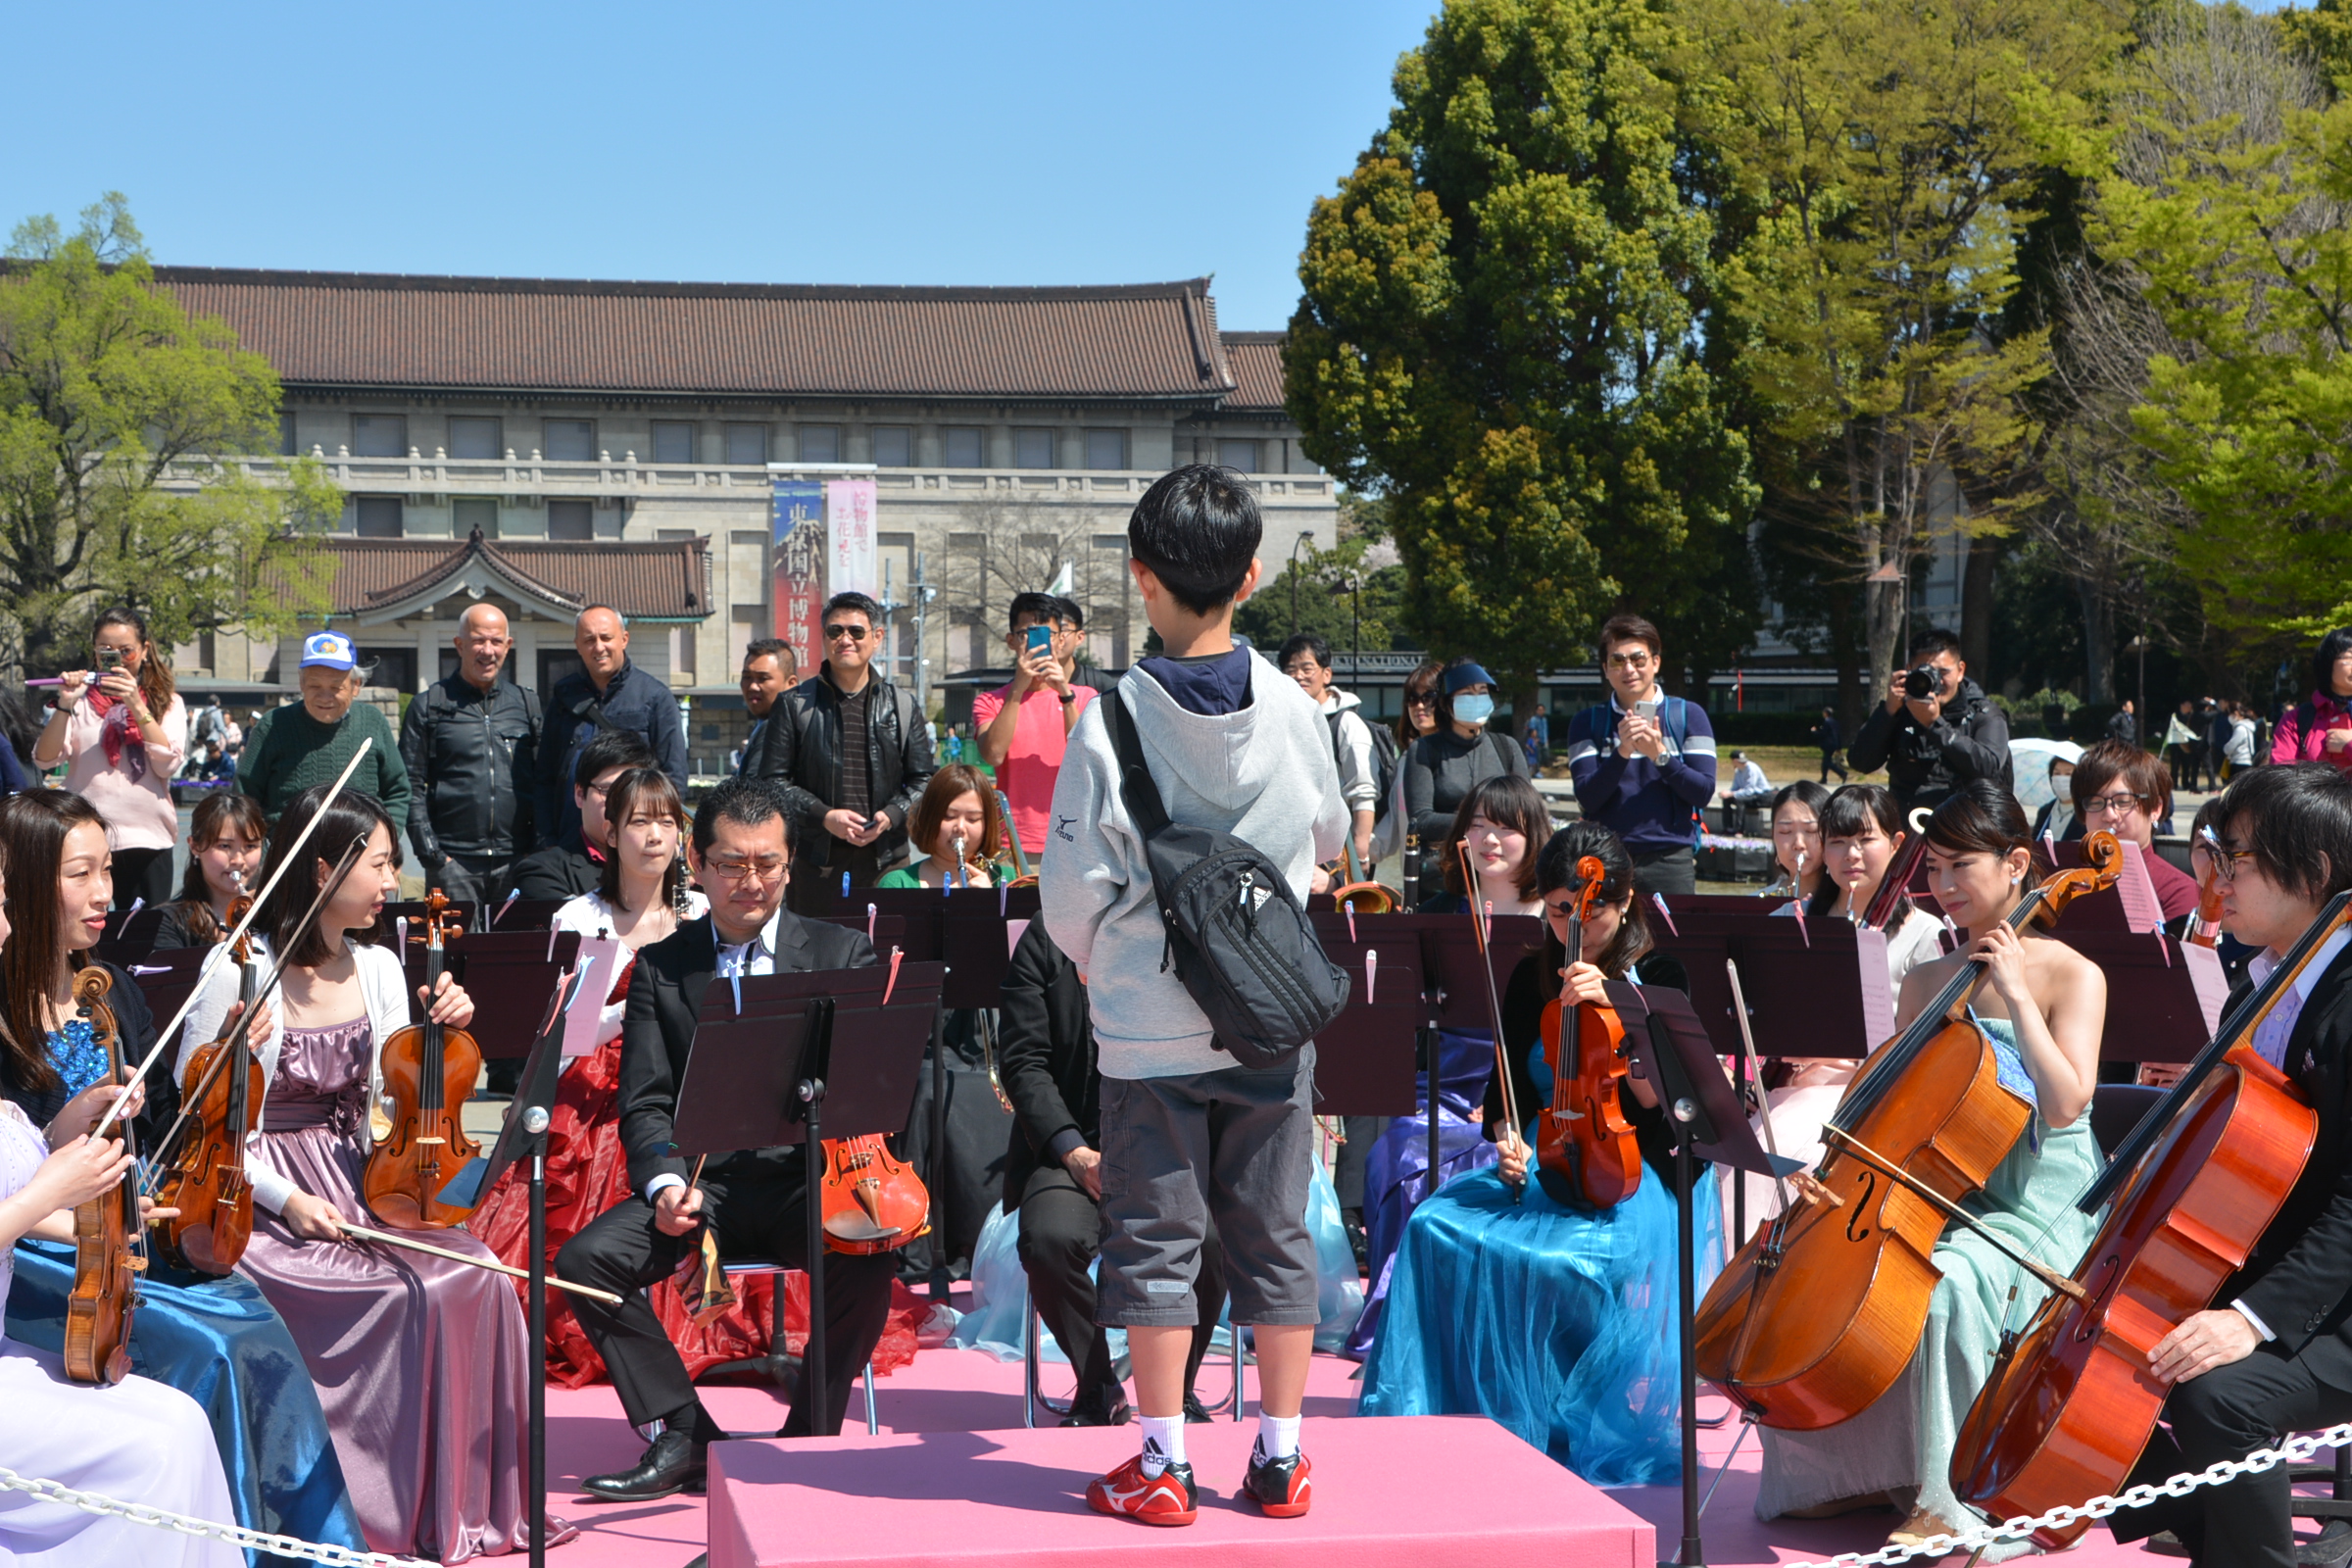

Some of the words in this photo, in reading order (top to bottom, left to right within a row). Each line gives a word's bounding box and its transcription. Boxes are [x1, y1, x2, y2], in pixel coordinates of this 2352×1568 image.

[787, 502, 809, 668] 東京国立博物館
